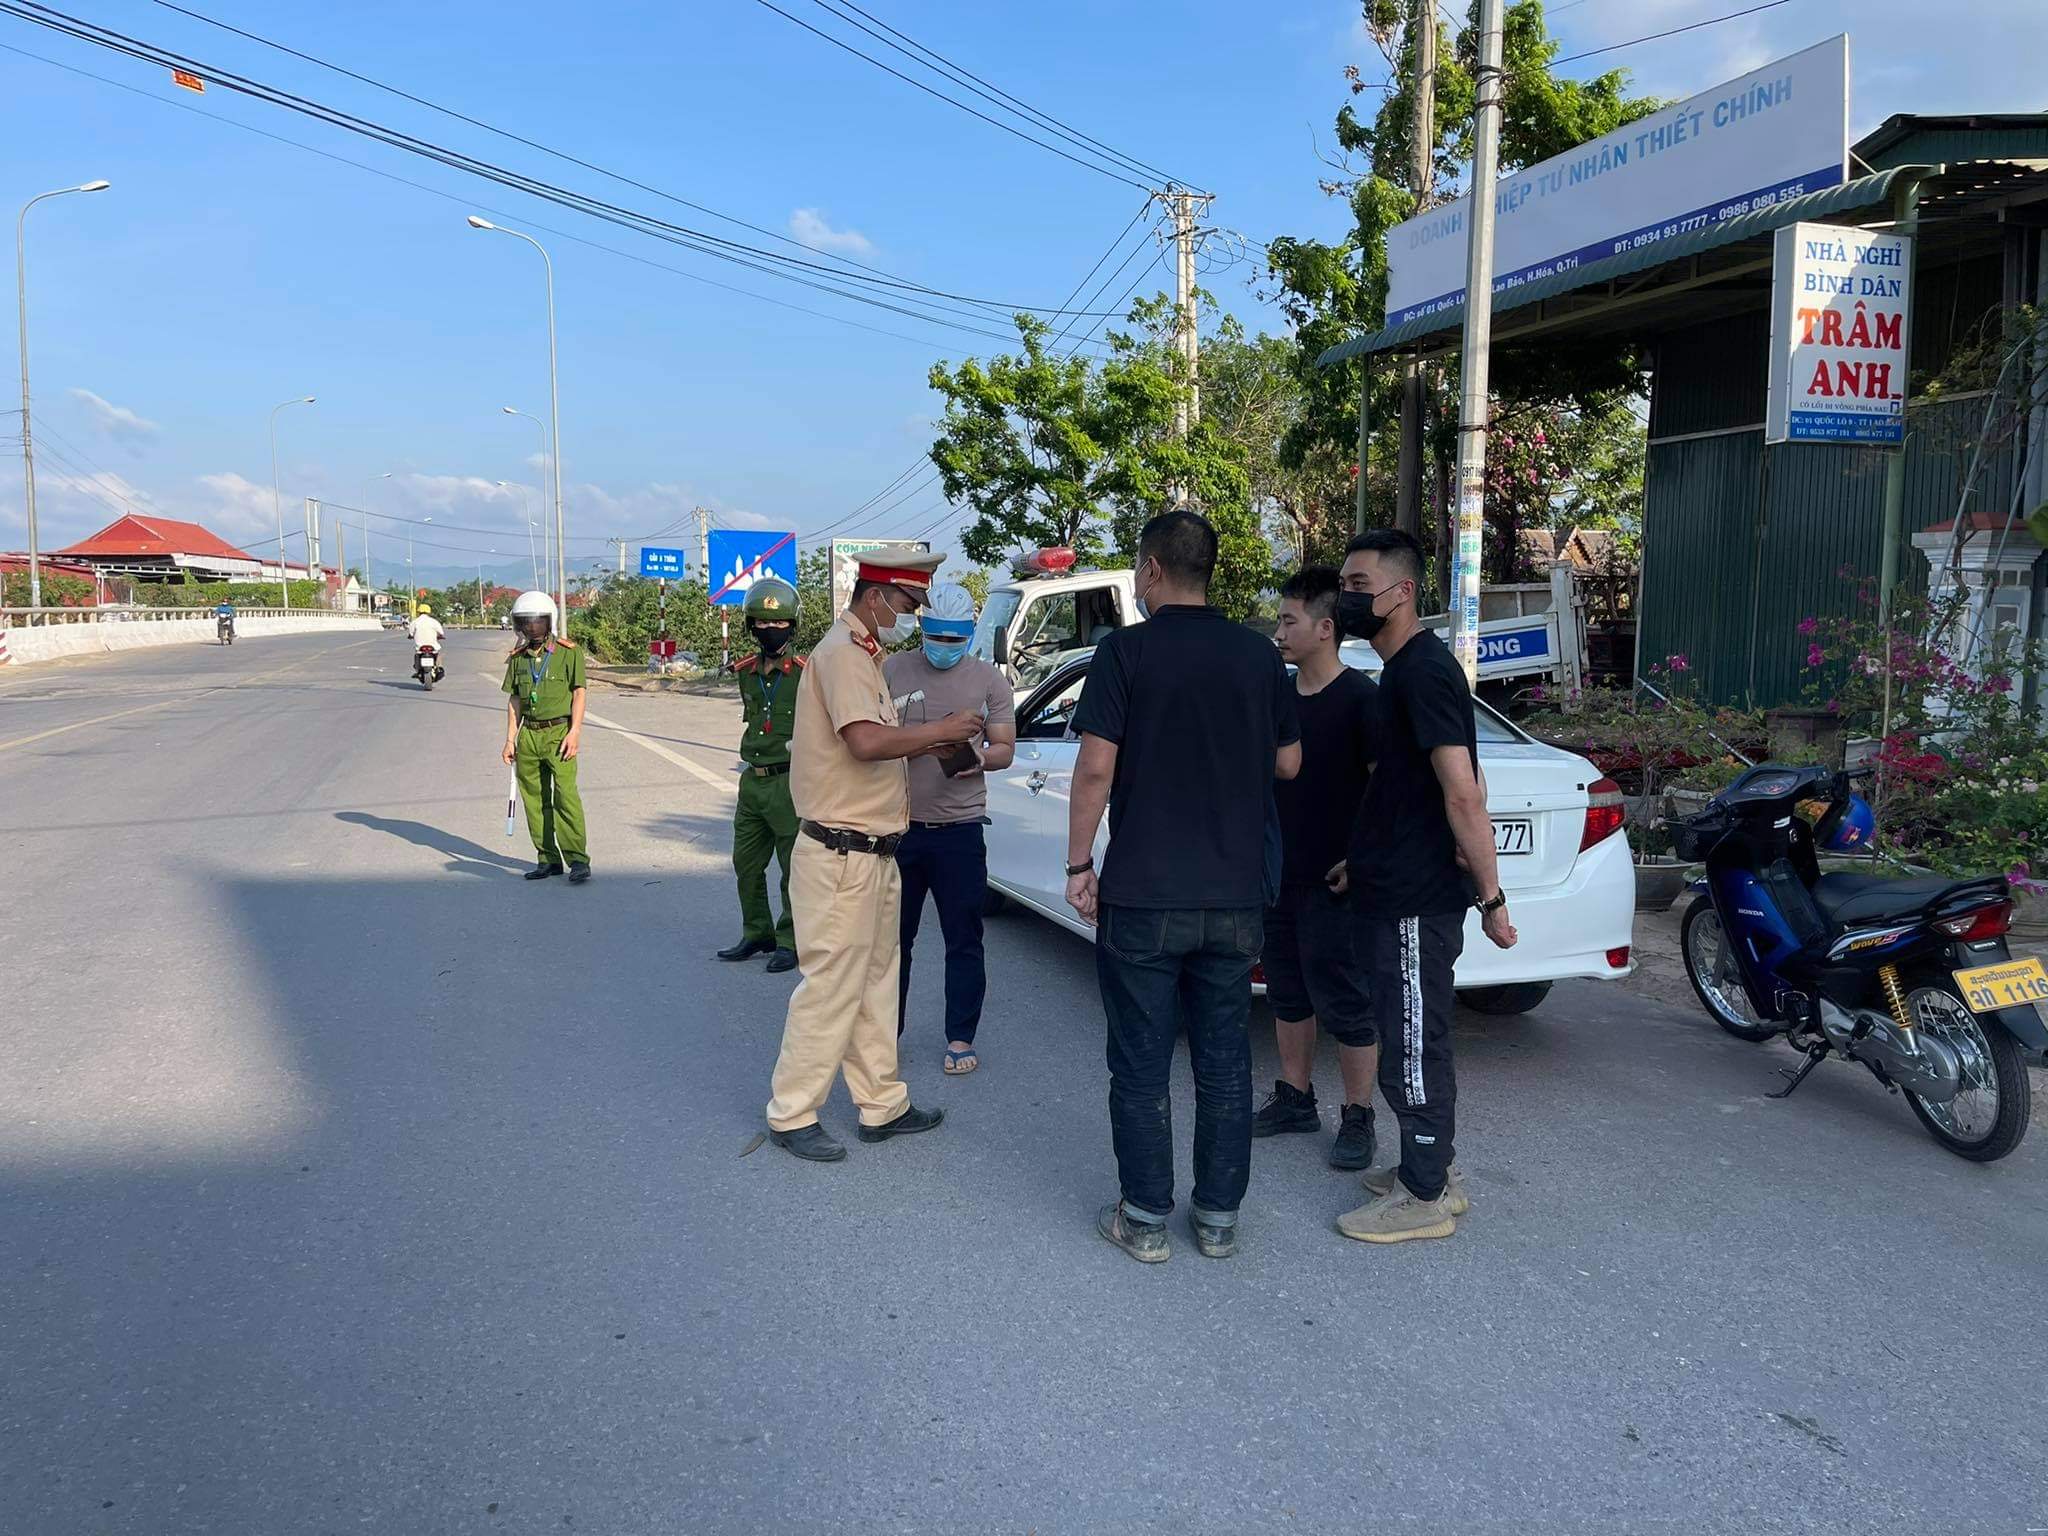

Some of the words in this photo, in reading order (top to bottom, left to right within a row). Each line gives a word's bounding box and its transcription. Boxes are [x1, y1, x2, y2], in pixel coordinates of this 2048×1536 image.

[1410, 212, 1462, 250] DOANH
[1537, 164, 1565, 197] TƯ
[1569, 142, 1628, 186] NHÂN
[1635, 106, 1704, 159] THIẾT
[1713, 74, 1793, 128] CHÍNH
[1634, 231, 1660, 248] 0934
[1664, 225, 1677, 238] 93
[1681, 214, 1708, 233] 7777
[1719, 201, 1749, 220] 0986
[1752, 192, 1776, 210] 080
[1779, 183, 1804, 201] 555
[1805, 238, 1847, 262] NHÀ
[1854, 242, 1902, 266] NGHỈ
[1804, 268, 1853, 294] BÌNH
[1861, 274, 1902, 297] DÂN
[1797, 300, 1903, 349] TRÂM
[1807, 359, 1891, 399] ANH
[1494, 824, 1526, 850] .77
[2004, 977, 2048, 1001] 1116
